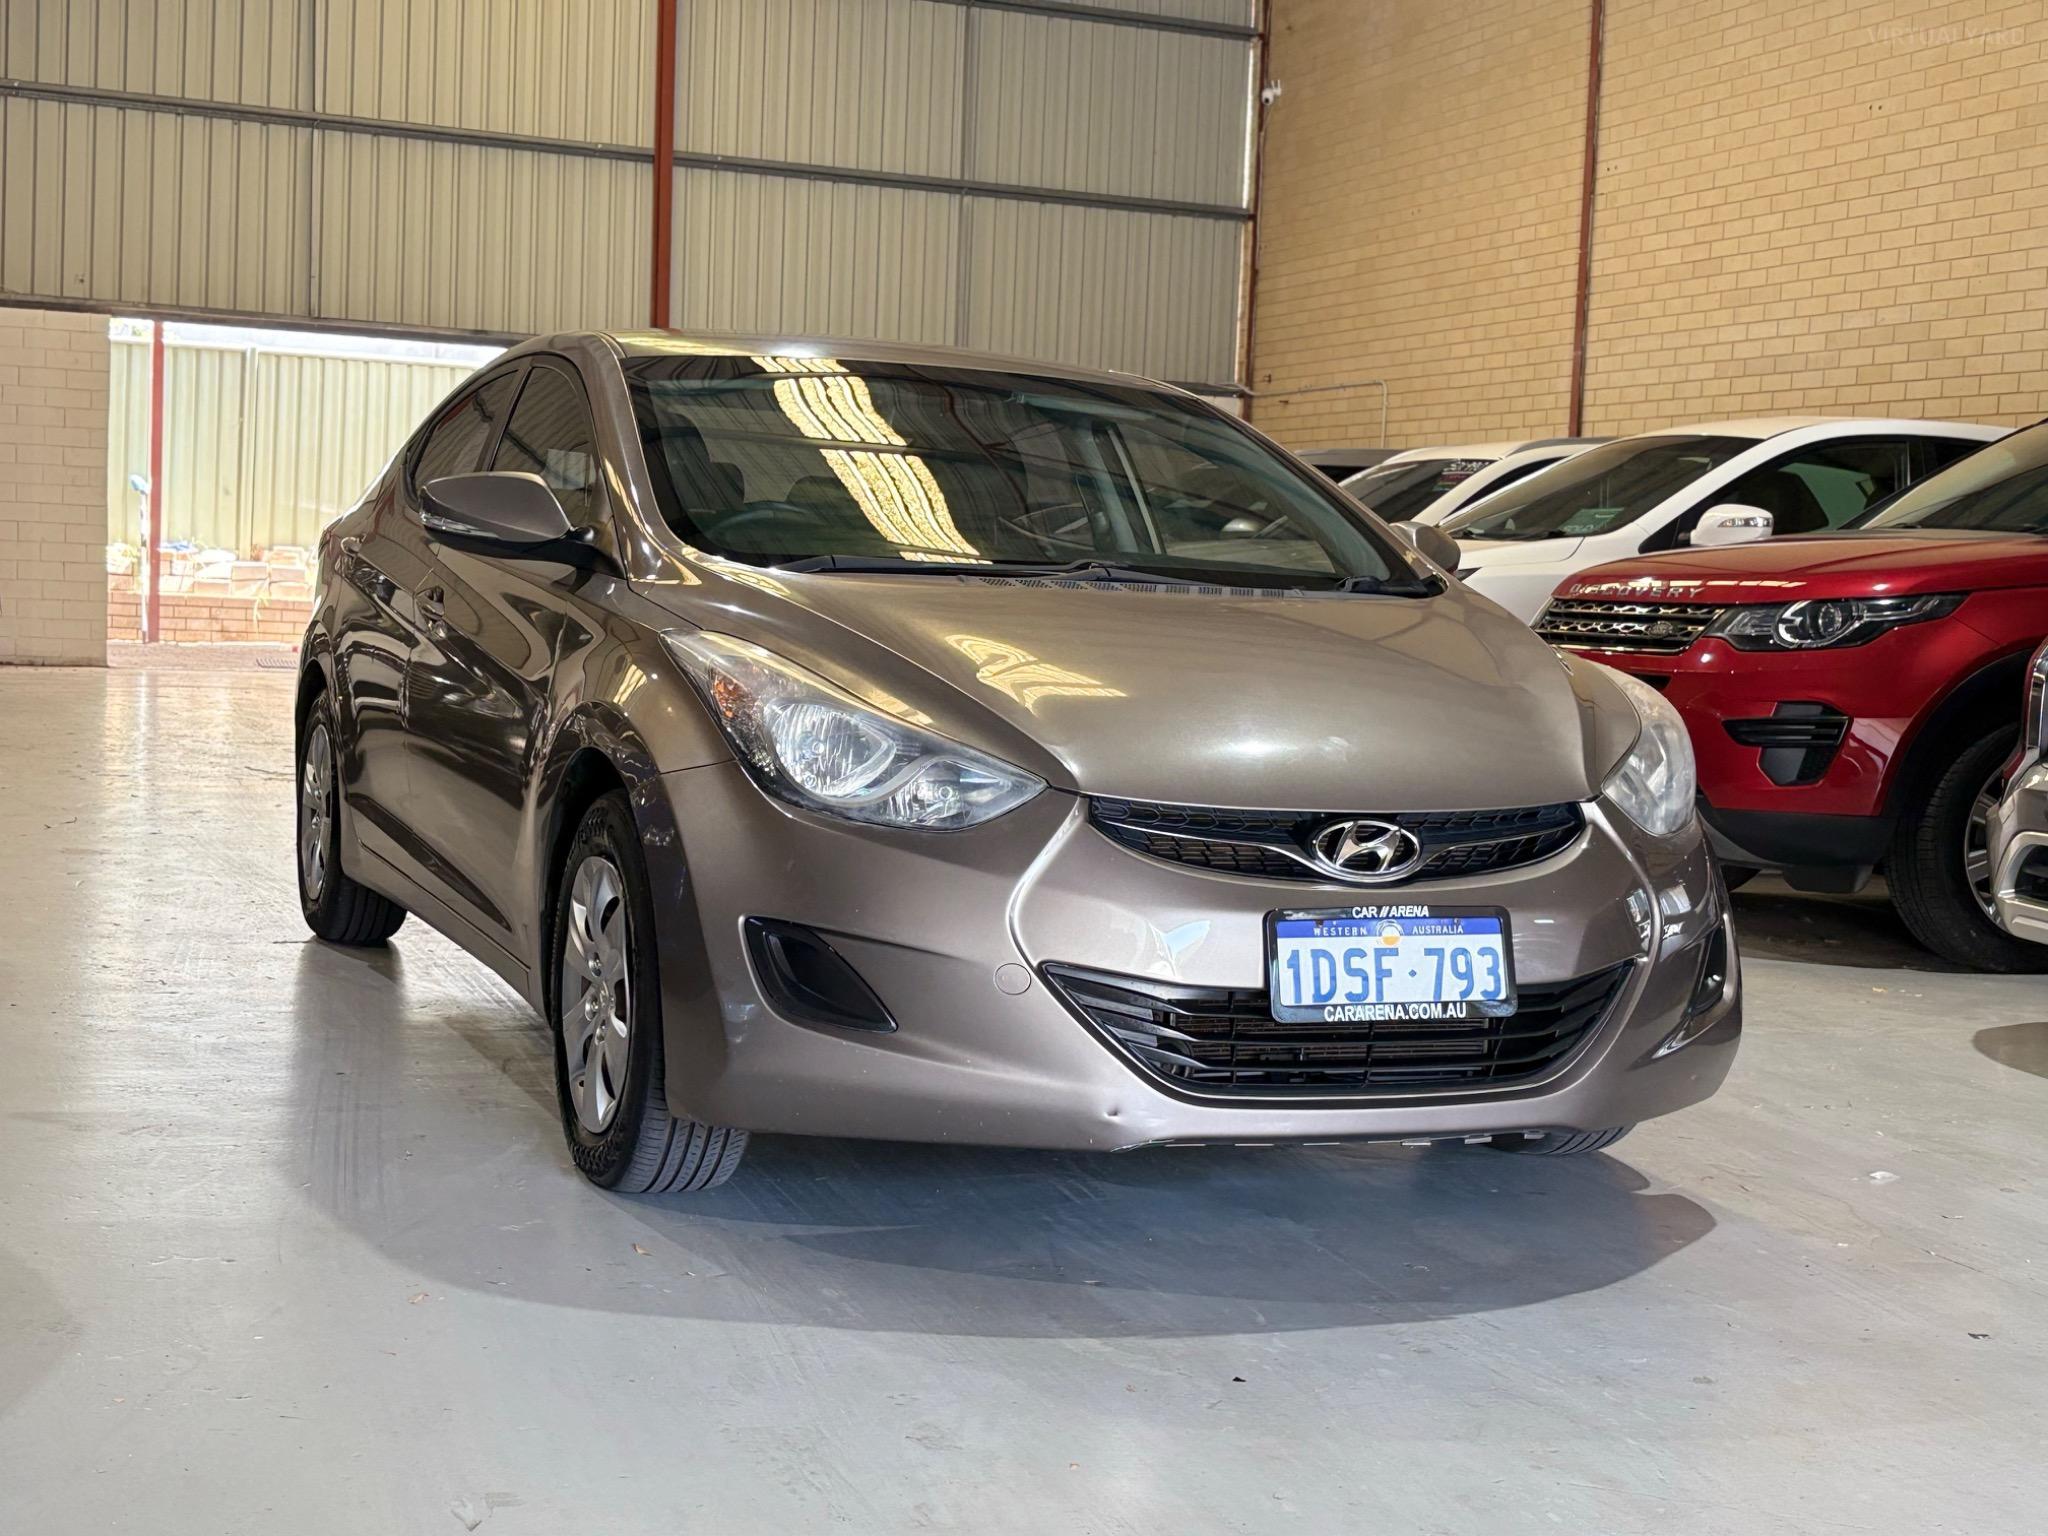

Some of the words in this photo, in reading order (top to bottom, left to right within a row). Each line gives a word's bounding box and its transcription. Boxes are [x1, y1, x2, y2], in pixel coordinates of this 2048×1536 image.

[1569, 583, 1705, 598] DISCOVERY
[1352, 906, 1377, 918] CAR
[1390, 905, 1429, 918] ARENA
[1313, 926, 1368, 937] WESTERN
[1412, 924, 1464, 936] AUSTRALIA
[1286, 947, 1399, 1004] 1DSF
[1424, 946, 1500, 1001] 793
[1324, 1002, 1467, 1022] CARARENA.COM.AU
